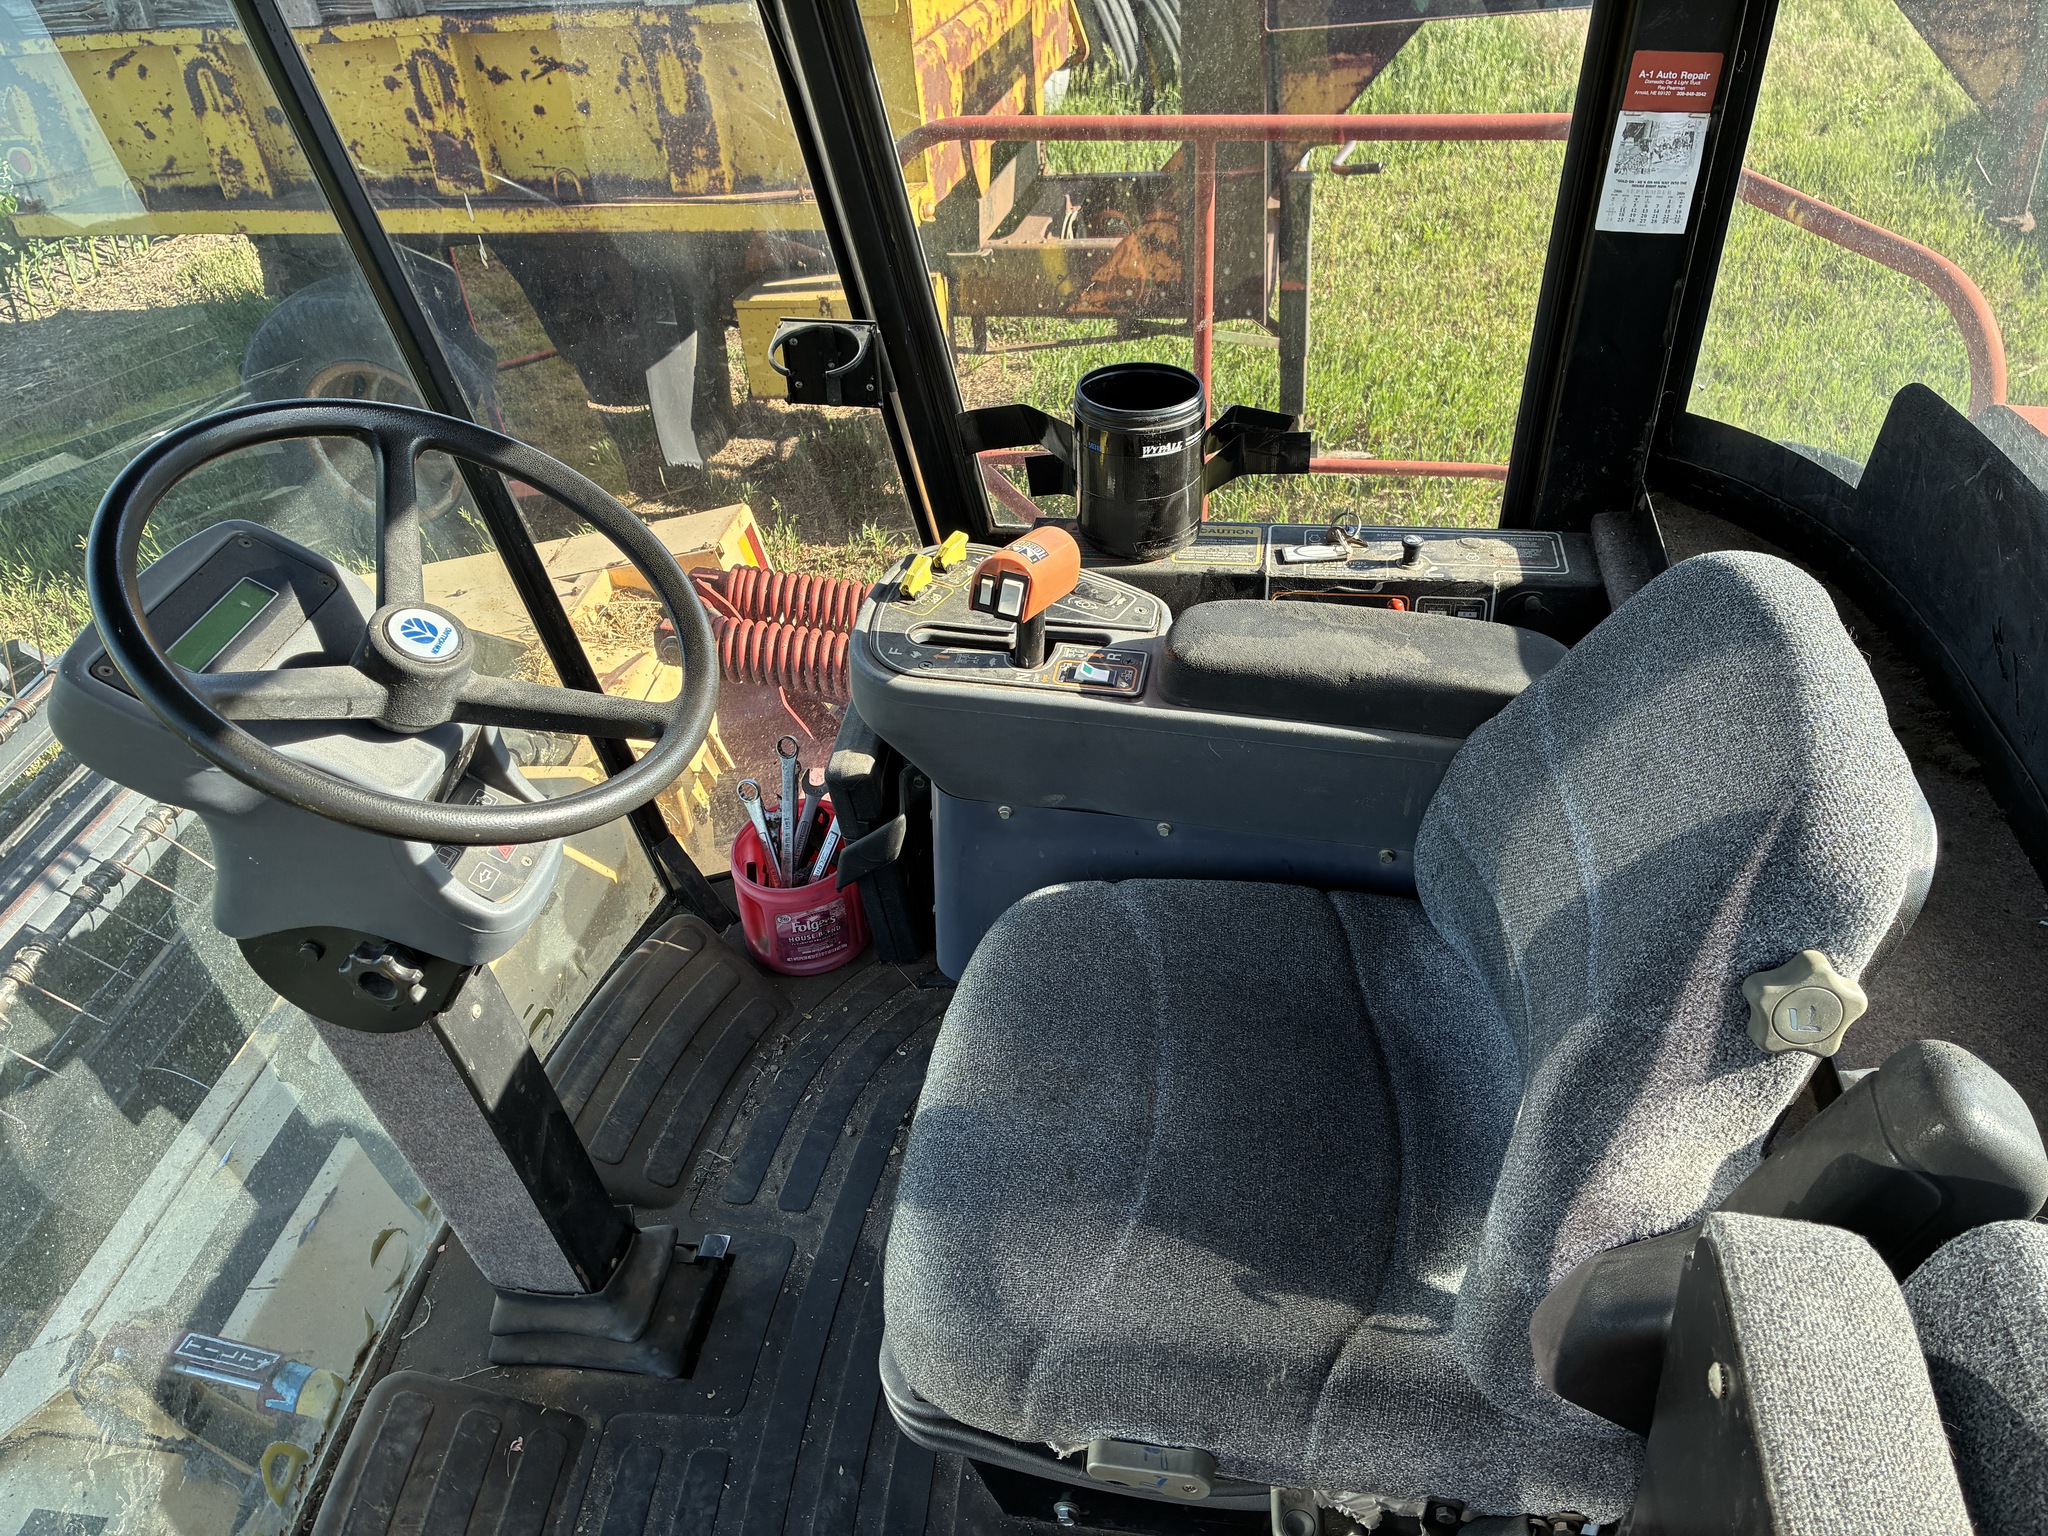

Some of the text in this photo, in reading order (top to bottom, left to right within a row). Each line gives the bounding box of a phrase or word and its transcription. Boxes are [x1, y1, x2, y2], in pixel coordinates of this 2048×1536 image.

[1638, 70, 1711, 80] A-1 Auto Repair
[1142, 440, 1183, 455] WYPALL
[430, 627, 452, 655] NEW HOLLAND
[888, 647, 903, 655] F
[1106, 652, 1122, 661] R
[1015, 672, 1032, 681] N
[792, 915, 836, 933] Folgers
[788, 934, 816, 942] HOUSE
[818, 926, 841, 937] BND
